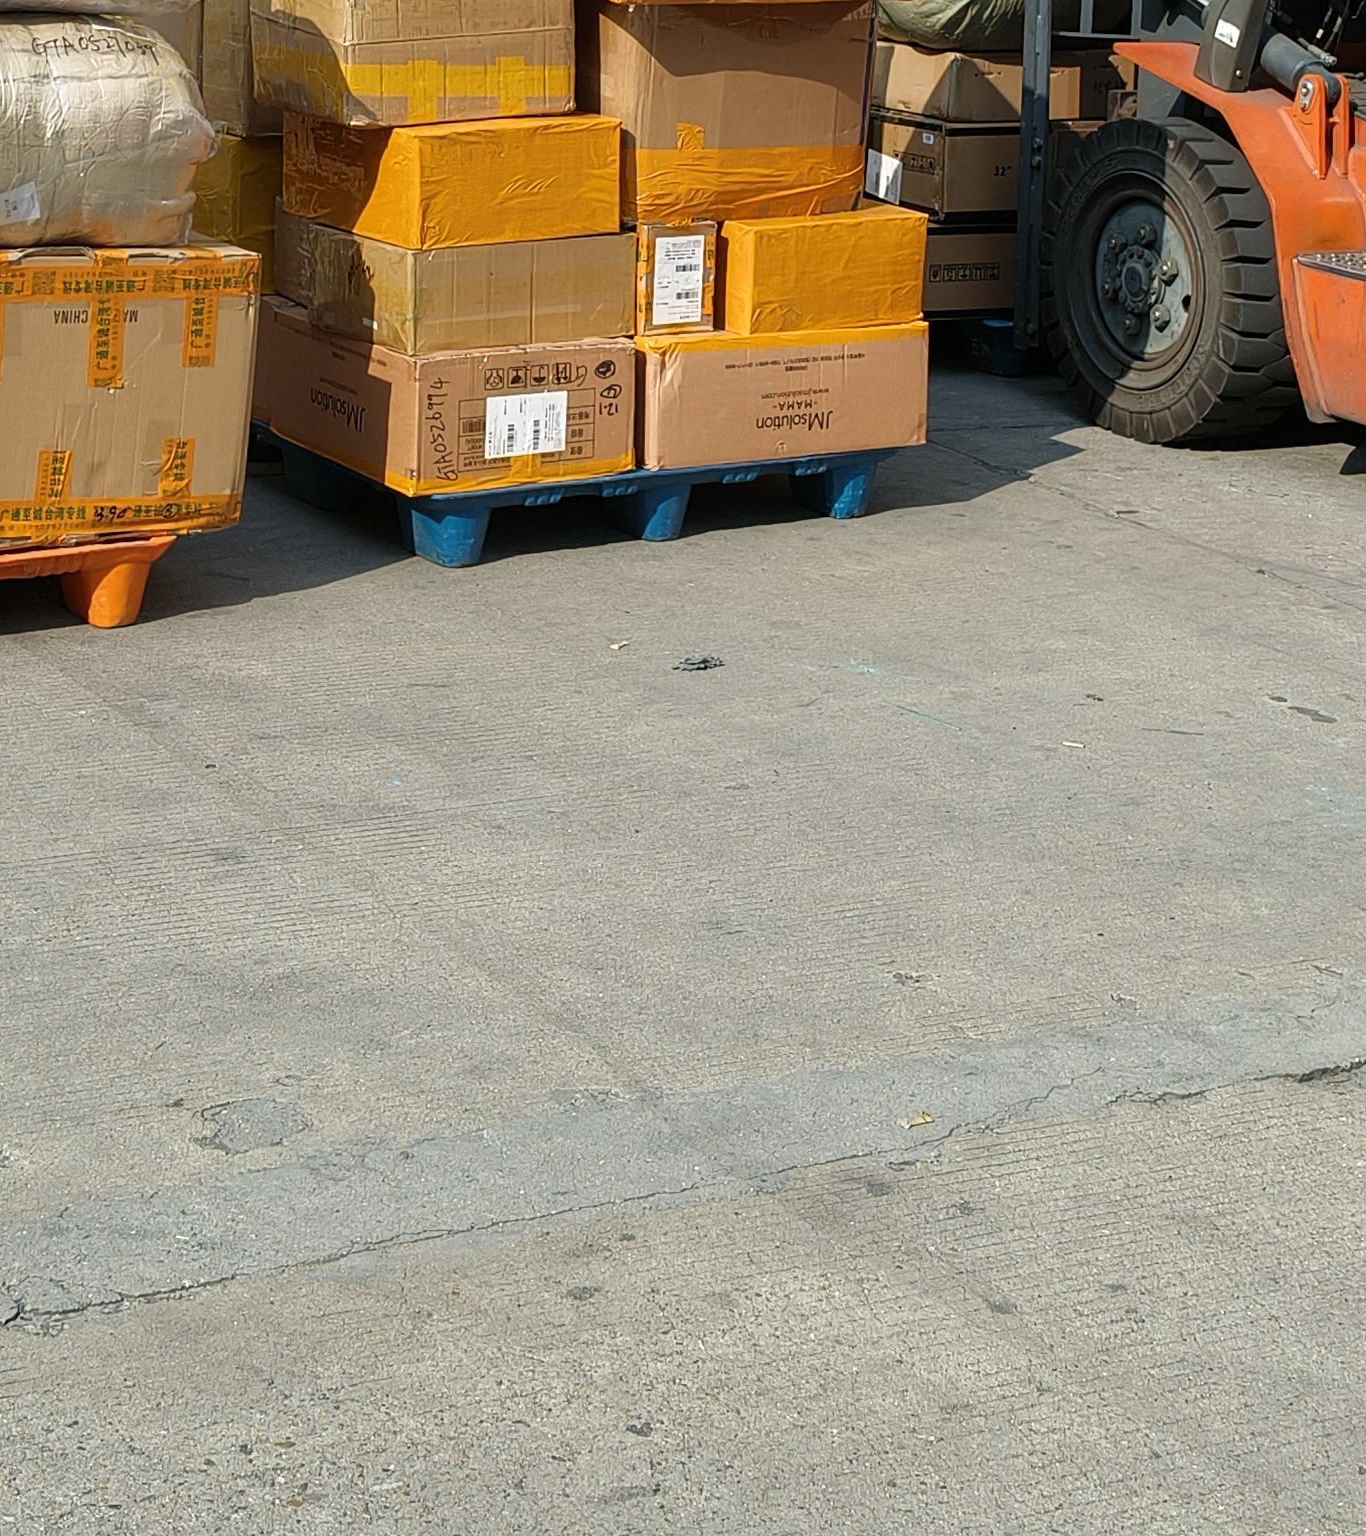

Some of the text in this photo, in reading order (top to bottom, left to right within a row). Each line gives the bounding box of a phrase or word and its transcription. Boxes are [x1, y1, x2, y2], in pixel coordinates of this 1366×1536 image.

[53, 310, 88, 324] CHINA
[310, 388, 365, 433] JMsolution
[755, 410, 834, 432] JMsolution
